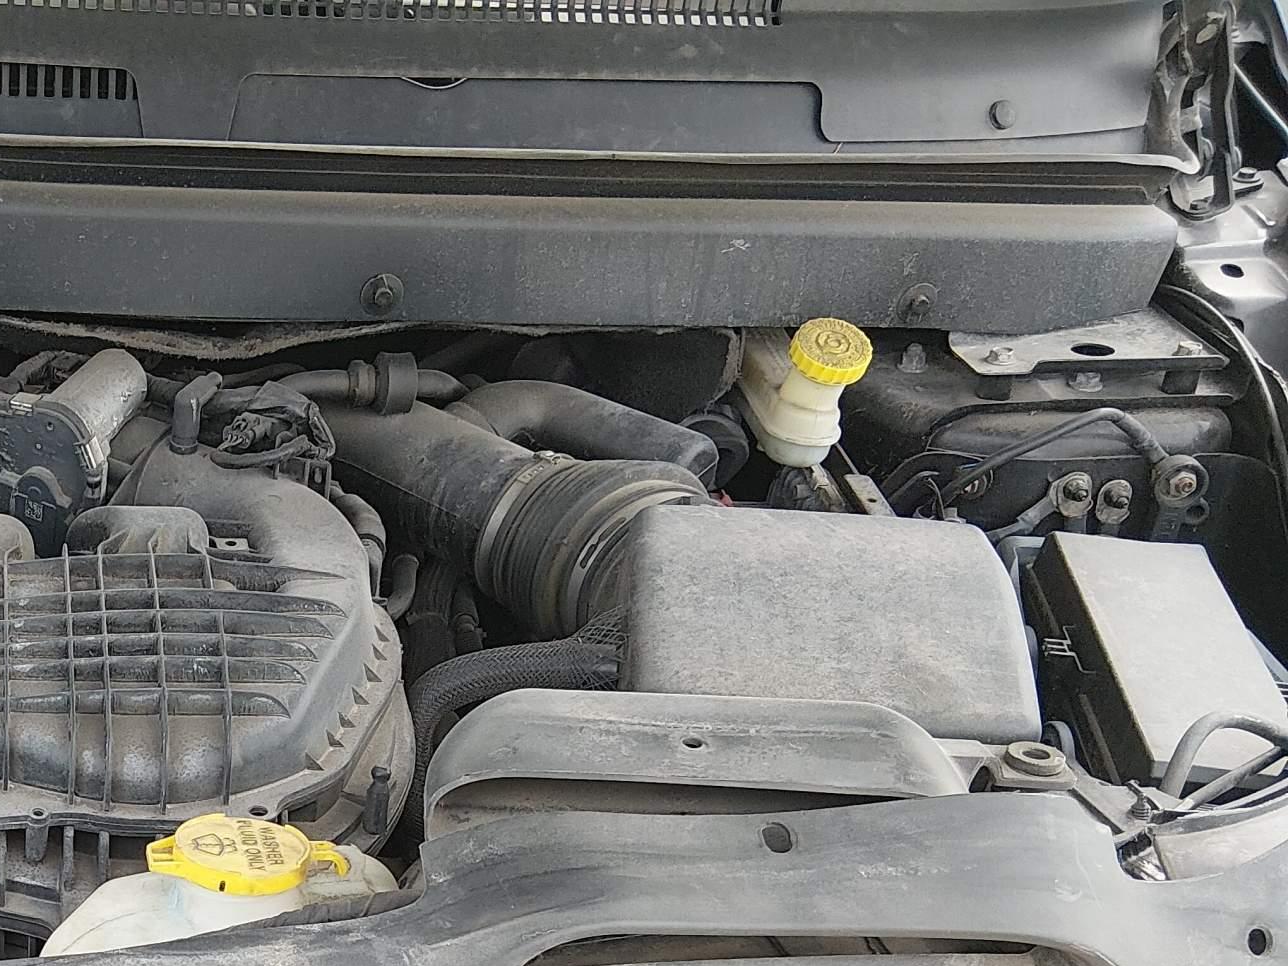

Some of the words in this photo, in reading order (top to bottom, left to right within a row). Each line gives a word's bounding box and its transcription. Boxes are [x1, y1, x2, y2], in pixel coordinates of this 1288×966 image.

[236, 820, 258, 846] FLUID
[259, 826, 285, 866] WASHER
[244, 847, 267, 871] ONLY
